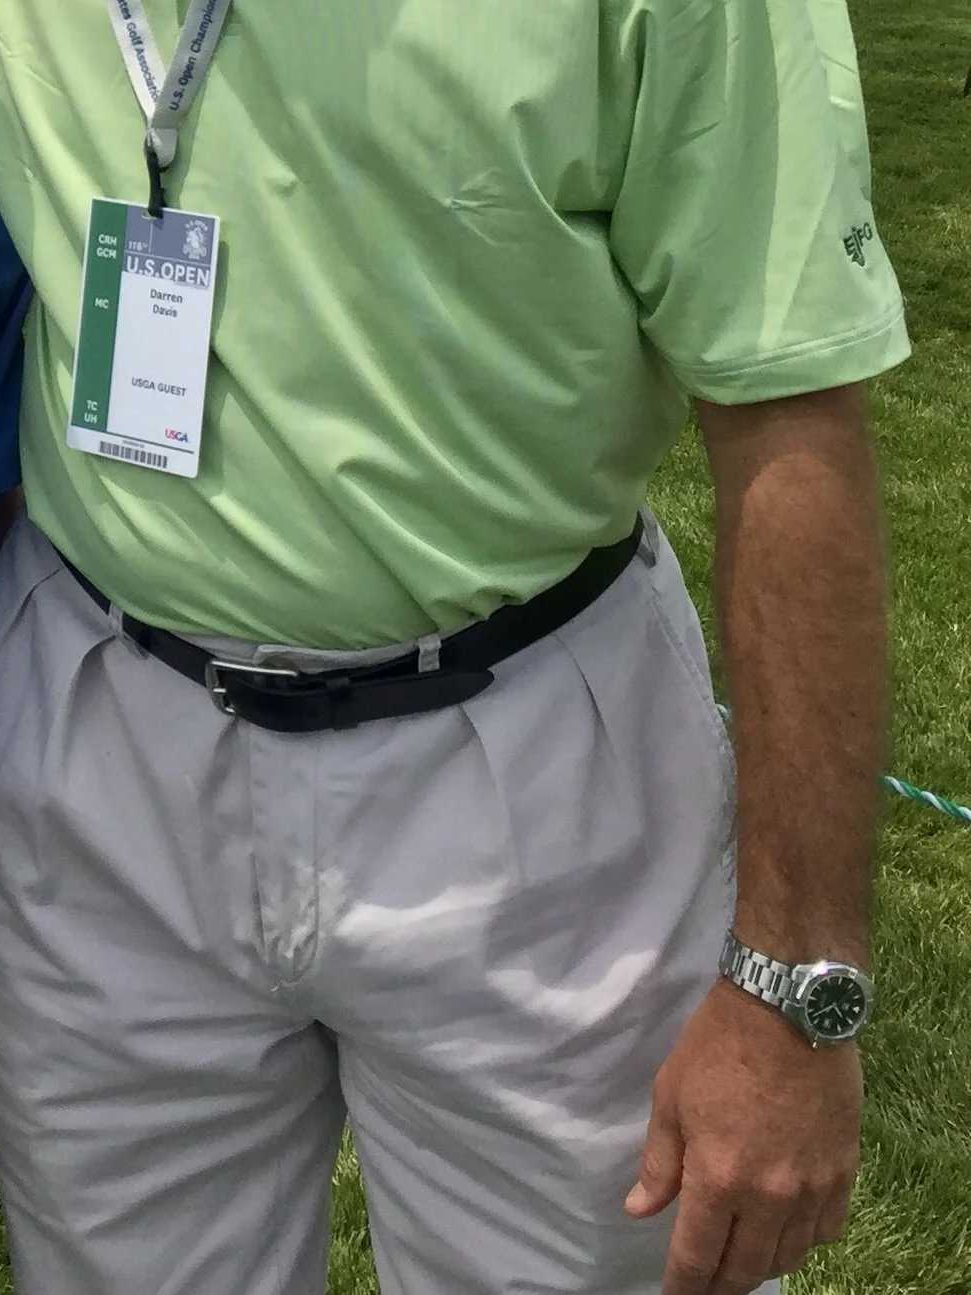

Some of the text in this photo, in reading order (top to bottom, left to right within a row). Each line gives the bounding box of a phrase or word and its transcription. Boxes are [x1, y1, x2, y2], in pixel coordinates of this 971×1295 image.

[126, 21, 143, 49] Golf
[135, 47, 159, 103] Associatio
[169, 88, 184, 111] U.S.
[178, 56, 196, 86] Open
[98, 234, 118, 245] CRH
[96, 247, 117, 259] GCM
[150, 288, 183, 303] Darren
[94, 298, 109, 309] MC
[152, 304, 178, 318] Davis
[131, 377, 186, 396] USGA GUEST
[86, 400, 98, 411] TC
[164, 428, 188, 442] USGA
